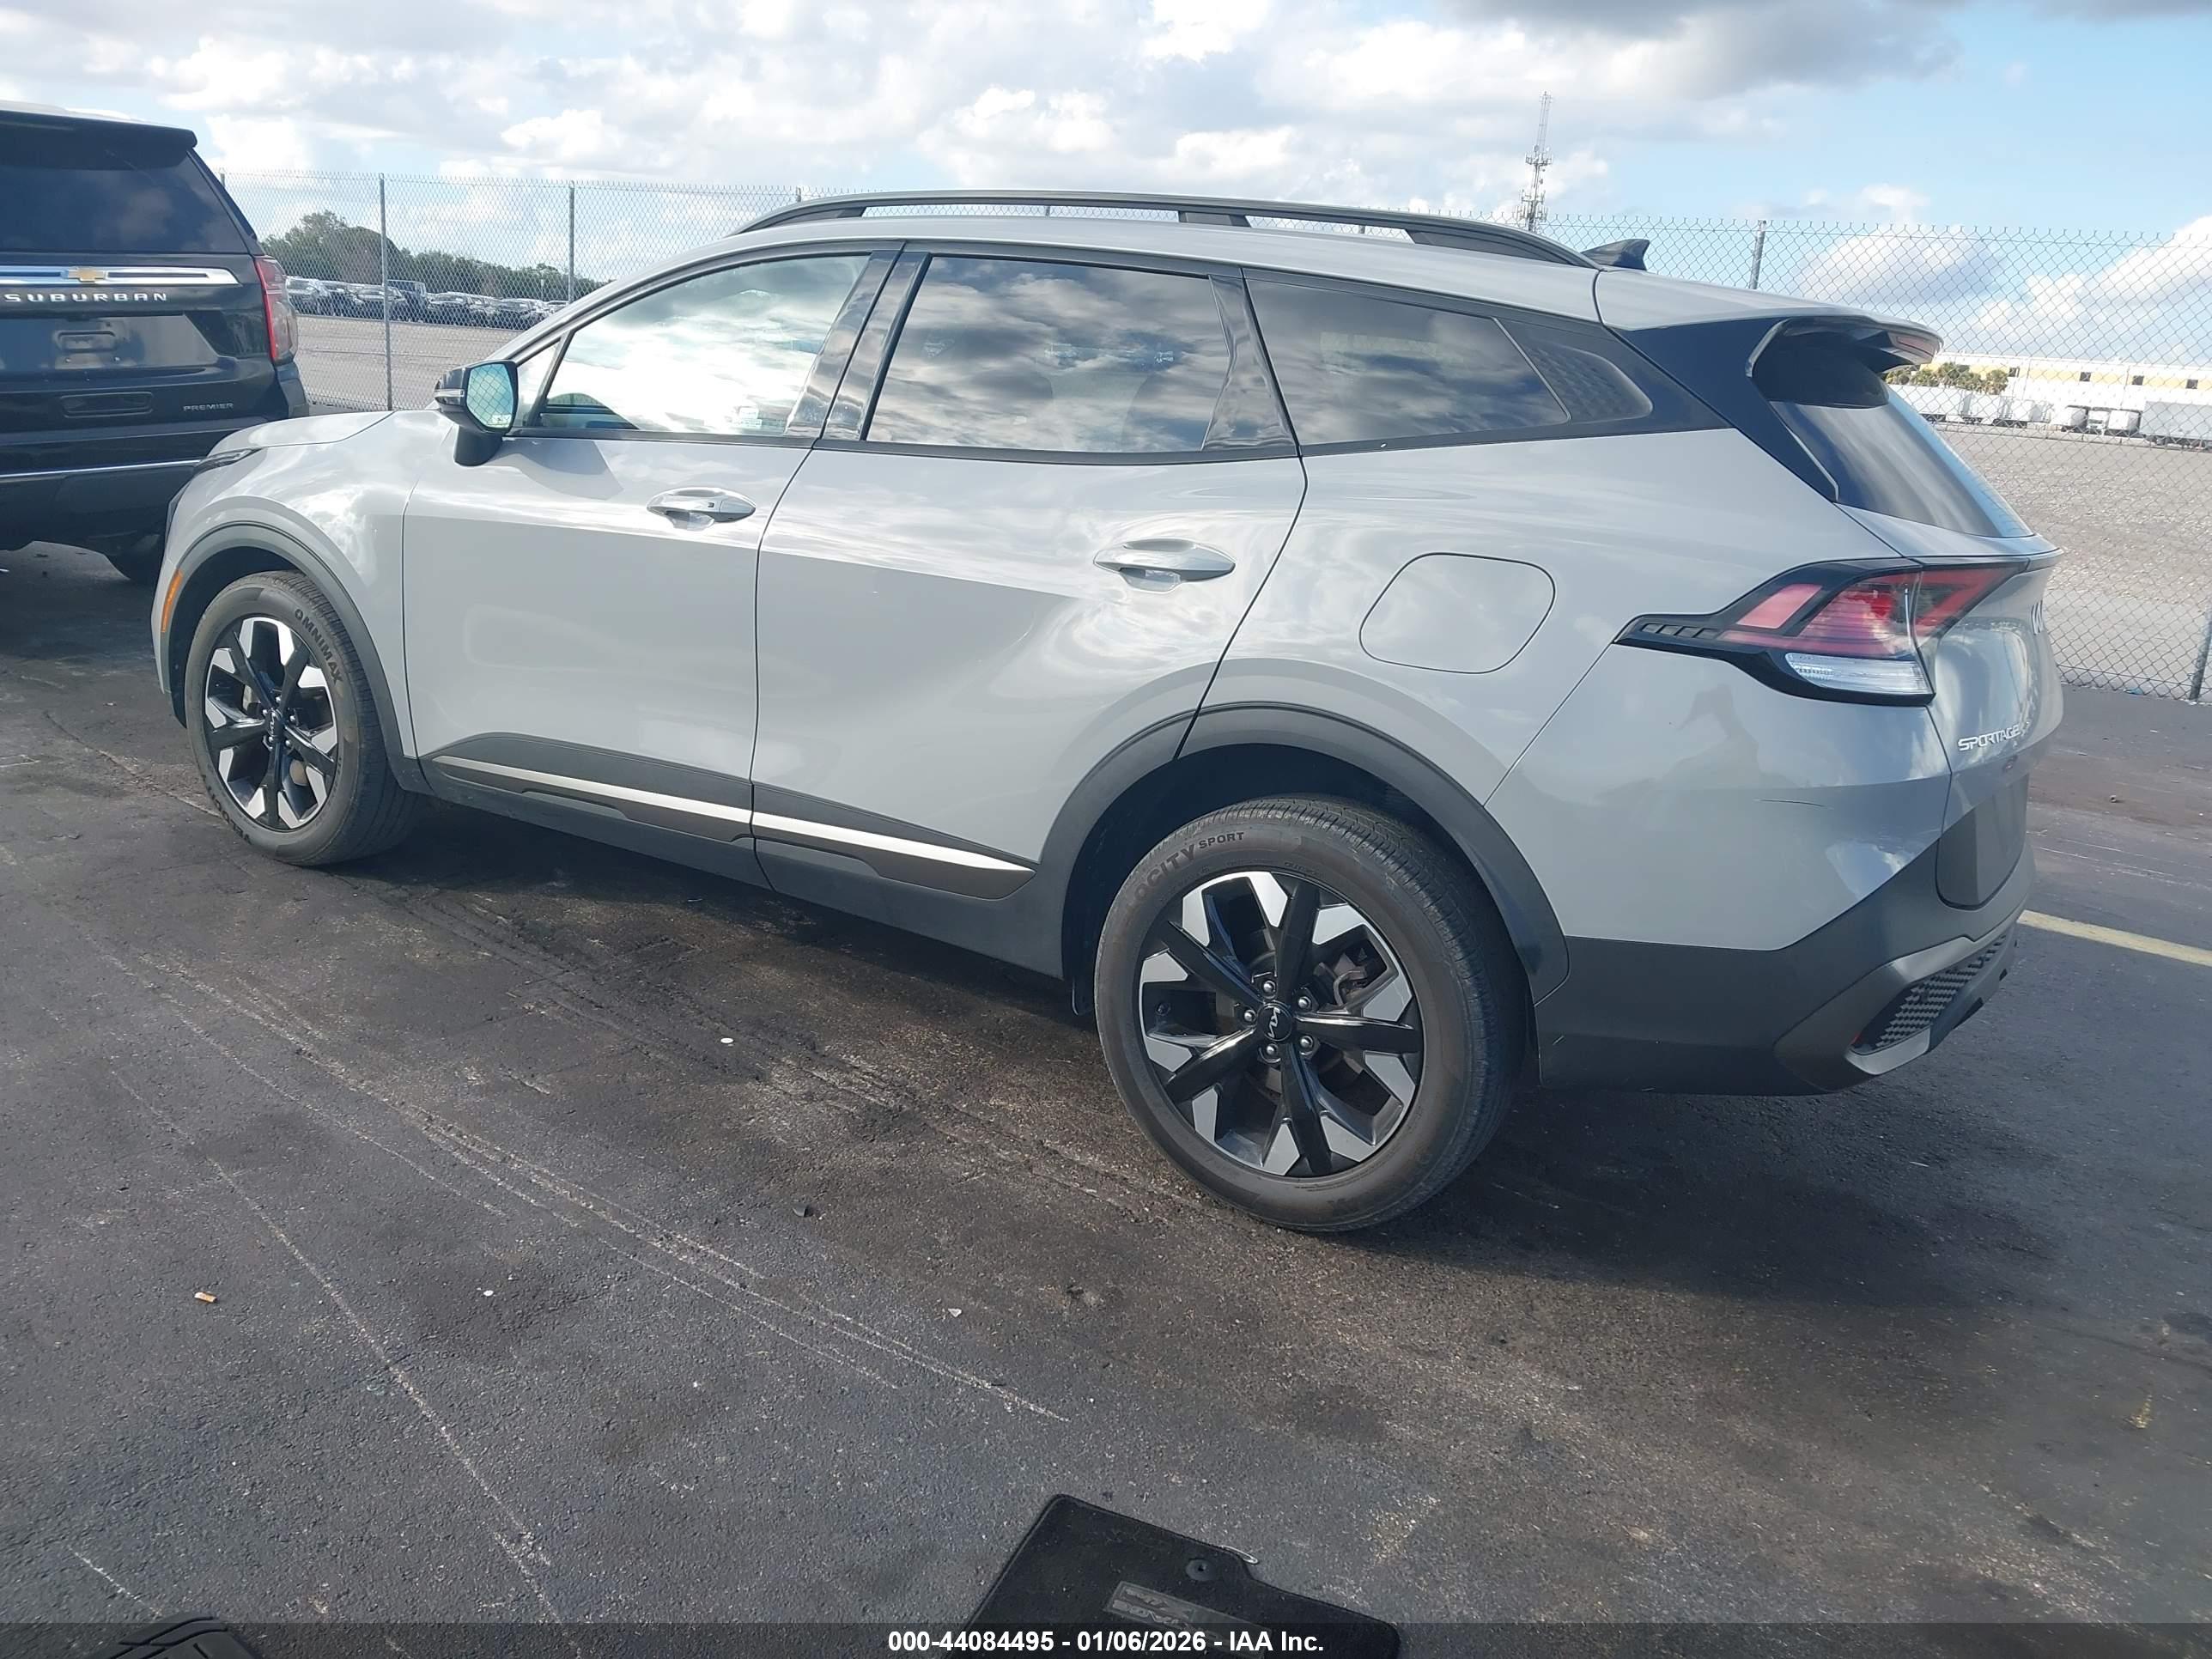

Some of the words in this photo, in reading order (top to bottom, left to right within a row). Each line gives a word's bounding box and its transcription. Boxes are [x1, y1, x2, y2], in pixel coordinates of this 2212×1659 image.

[3, 293, 167, 302] SUBURBAN
[183, 403, 234, 412] PREMIER
[295, 609, 343, 685] OMNIMAX
[1958, 724, 2021, 751] SPORTAGE
[1199, 832, 1244, 849] SPORT
